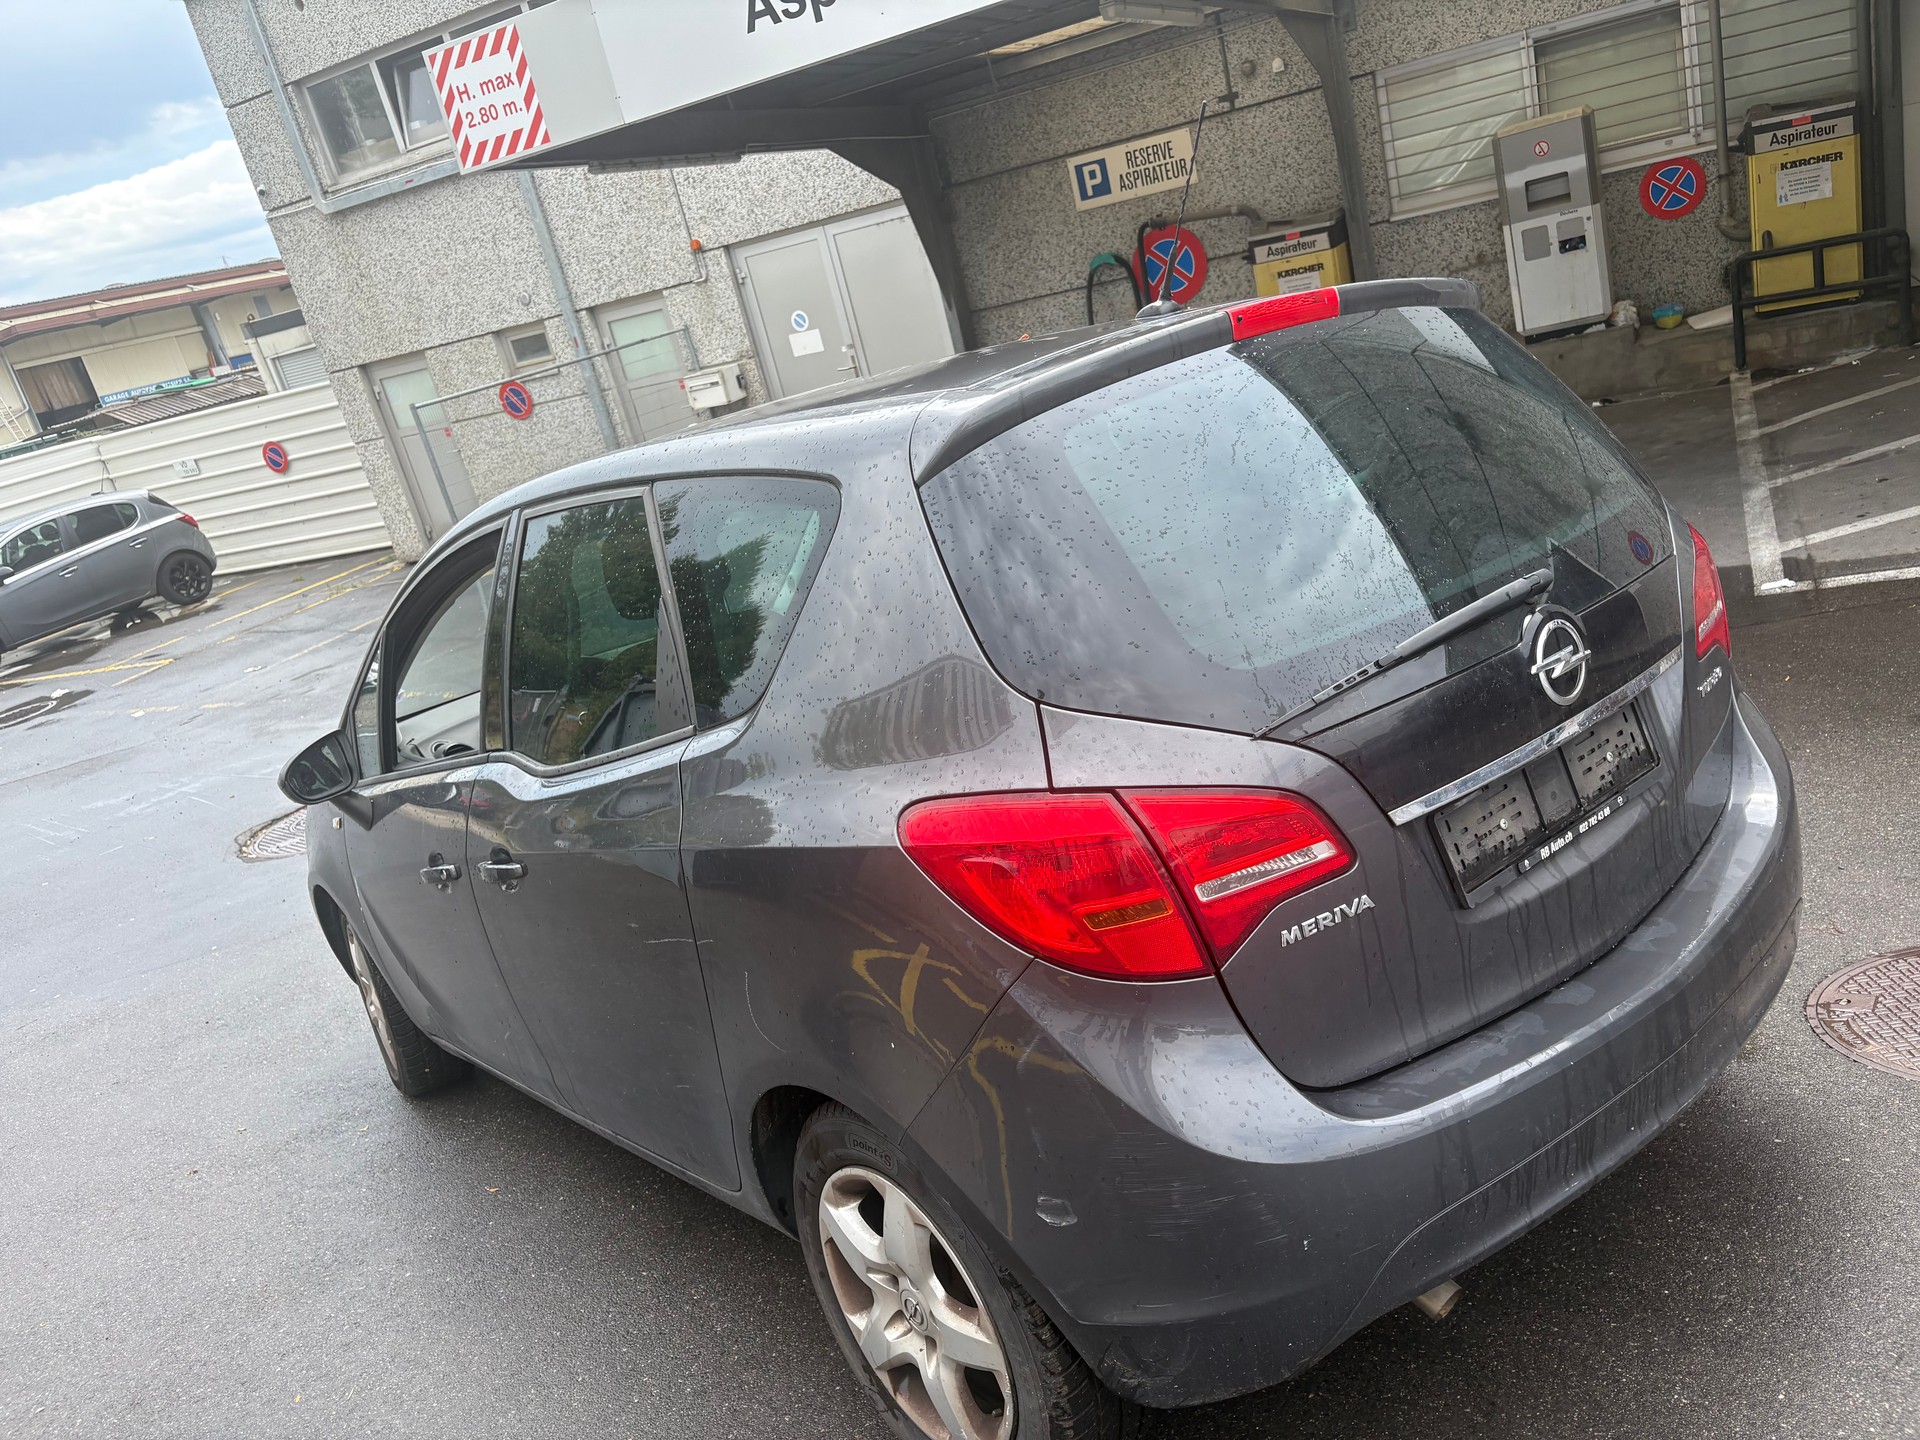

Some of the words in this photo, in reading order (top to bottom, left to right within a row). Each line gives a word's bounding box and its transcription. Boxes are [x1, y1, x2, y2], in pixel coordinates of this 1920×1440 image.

[456, 83, 476, 103] H.
[479, 72, 515, 96] max
[465, 103, 499, 129] 2.80
[502, 100, 523, 117] m.
[1769, 123, 1838, 147] Aspirateur
[1125, 141, 1175, 170] RESERVE
[1081, 163, 1103, 197] P
[1119, 158, 1189, 192] ASPIRATEUR
[1266, 239, 1318, 259] Aspirateur
[1550, 831, 1573, 854] Auto.ch
[1281, 894, 1376, 948] MERIVA
[852, 1138, 877, 1157] point
